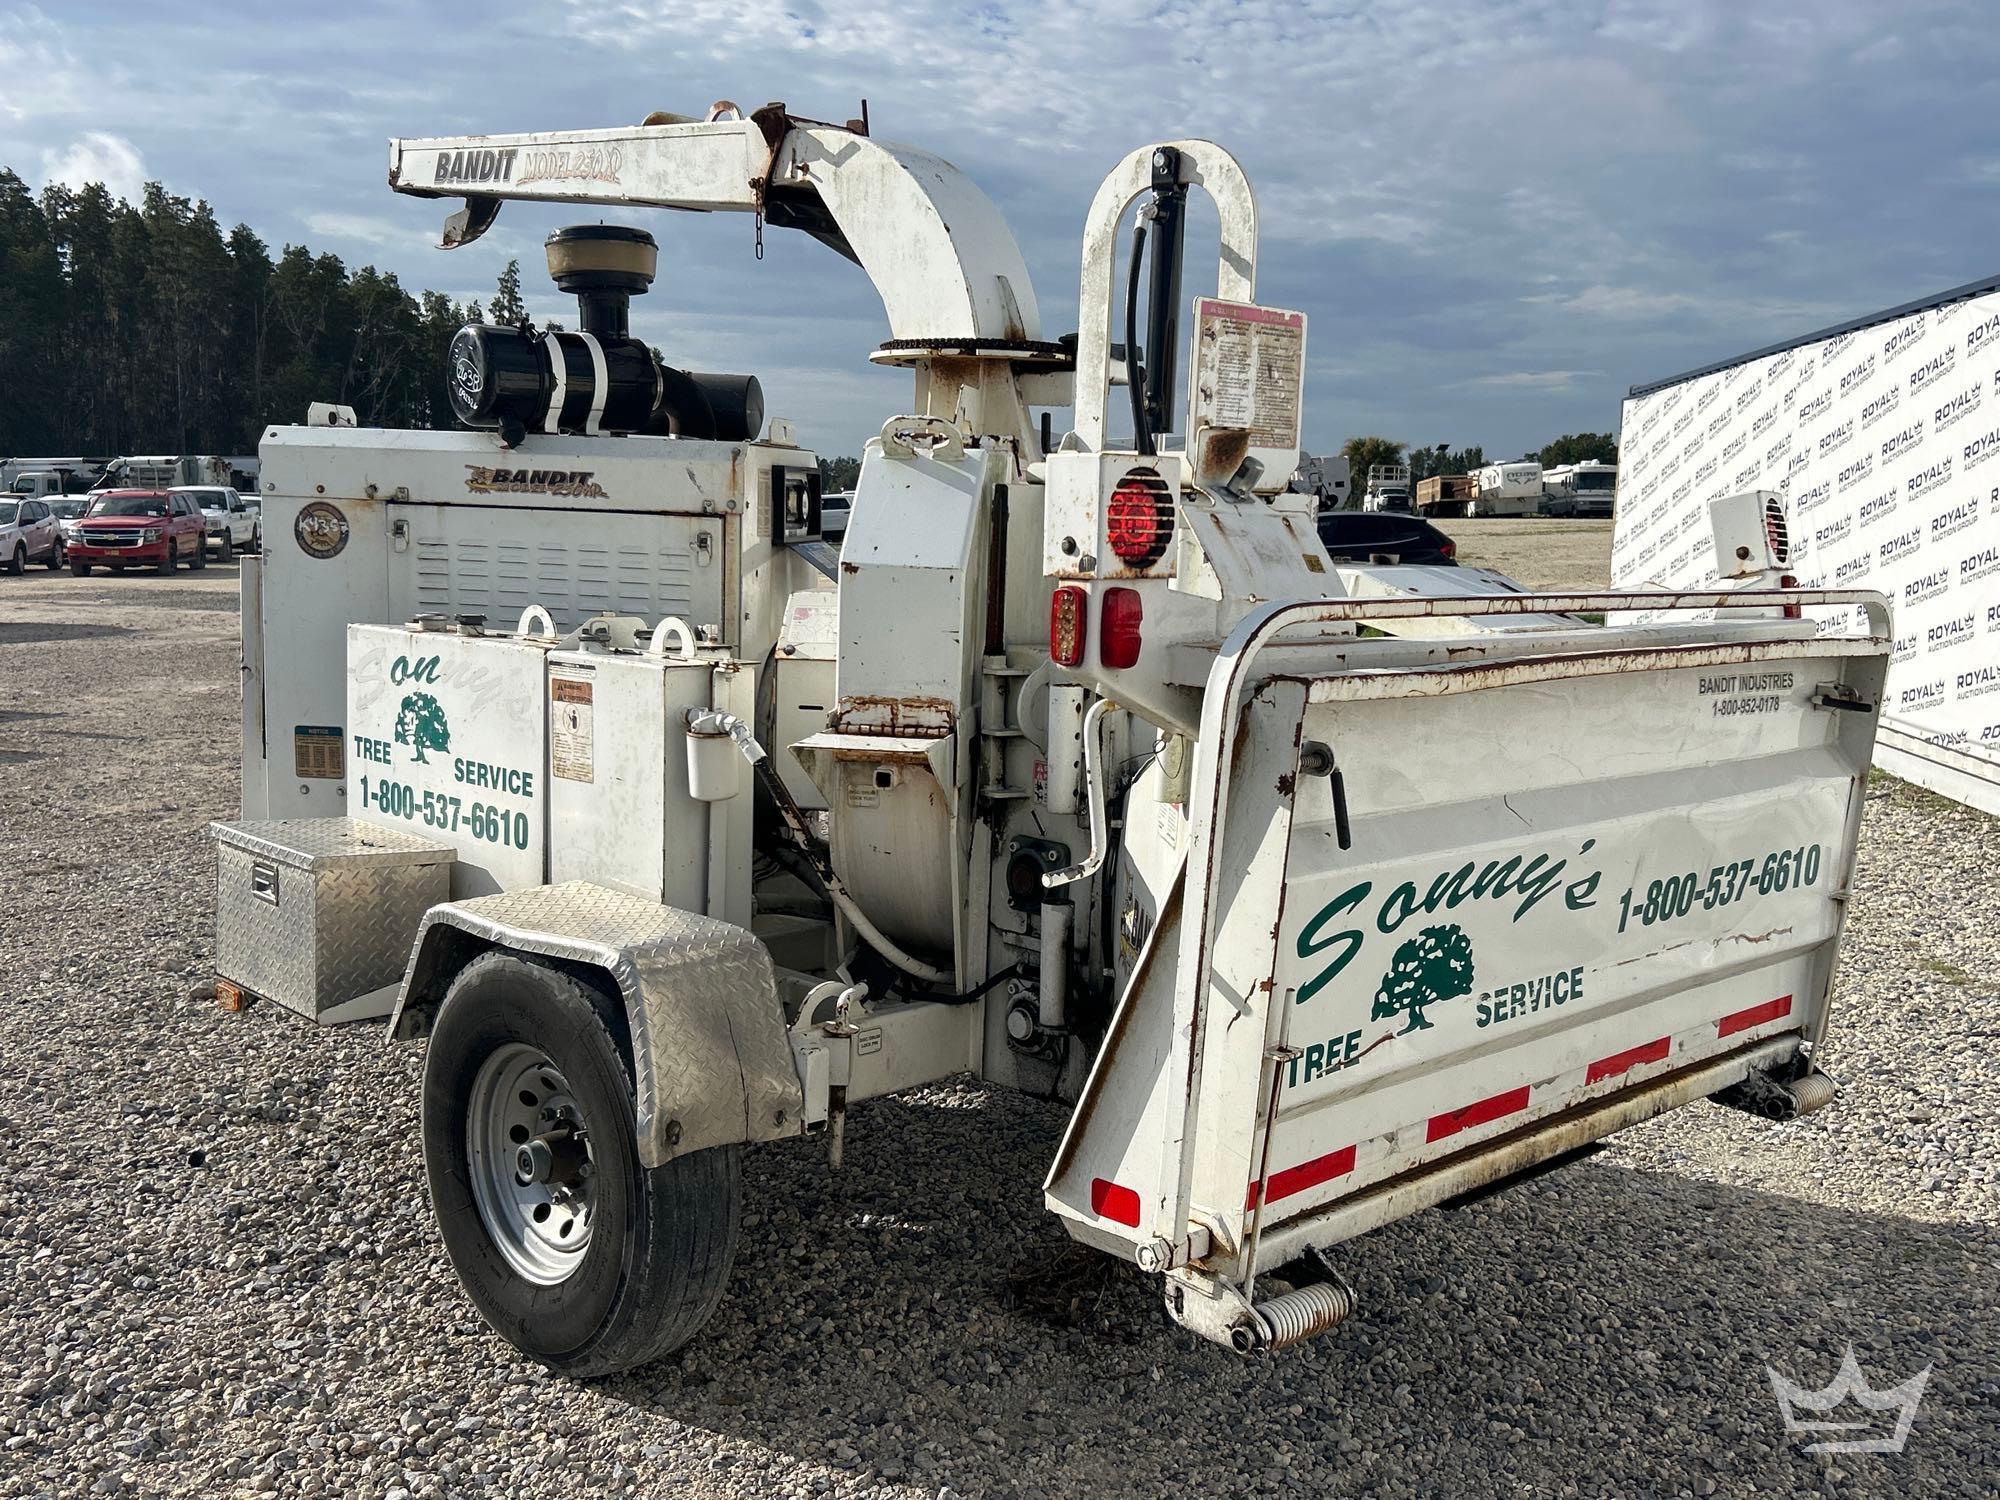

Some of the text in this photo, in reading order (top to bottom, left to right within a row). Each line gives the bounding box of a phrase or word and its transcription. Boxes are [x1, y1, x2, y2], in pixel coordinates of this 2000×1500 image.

[434, 149, 518, 184] BANDIT
[1885, 322, 1916, 355] ROYAL
[1967, 314, 2000, 347] ROYA
[1841, 361, 1867, 390] ROYAL
[1910, 354, 1945, 387] ROYAL
[1861, 392, 1891, 421] ROYAL
[1935, 390, 1971, 424] ROYAL
[1820, 424, 1846, 451] ROYAL
[1882, 428, 1914, 456] ROYAL
[492, 467, 595, 486] BANDIT
[1839, 459, 1865, 484] ROYAL
[1908, 463, 1942, 492] ROYAL
[1860, 493, 1889, 519] ROYAL
[1931, 504, 1968, 533] ROYAL
[1816, 519, 1844, 541] ROYAL
[1880, 533, 1912, 558] ROYAL
[1836, 556, 1863, 578] ROYAL
[1960, 546, 1999, 575] ROYAL
[1905, 573, 1939, 598] ROYAL
[1928, 617, 1964, 643] ROYAL
[1699, 673, 1794, 694] BANDIT INDUSTRIES
[1957, 666, 1996, 689] ROYAL
[1712, 696, 1780, 717] 1-800-952-0178
[1902, 683, 1935, 704] ROYAL
[354, 735, 392, 765] TREE
[454, 757, 534, 798] SERVICE
[360, 774, 529, 851] 1-800-537-6610
[1617, 843, 1821, 934] 1-800-537-6610
[1296, 838, 1602, 1005] Sonny's
[1475, 966, 1584, 1028] SERVICE
[1285, 1029, 1363, 1089] TREE
